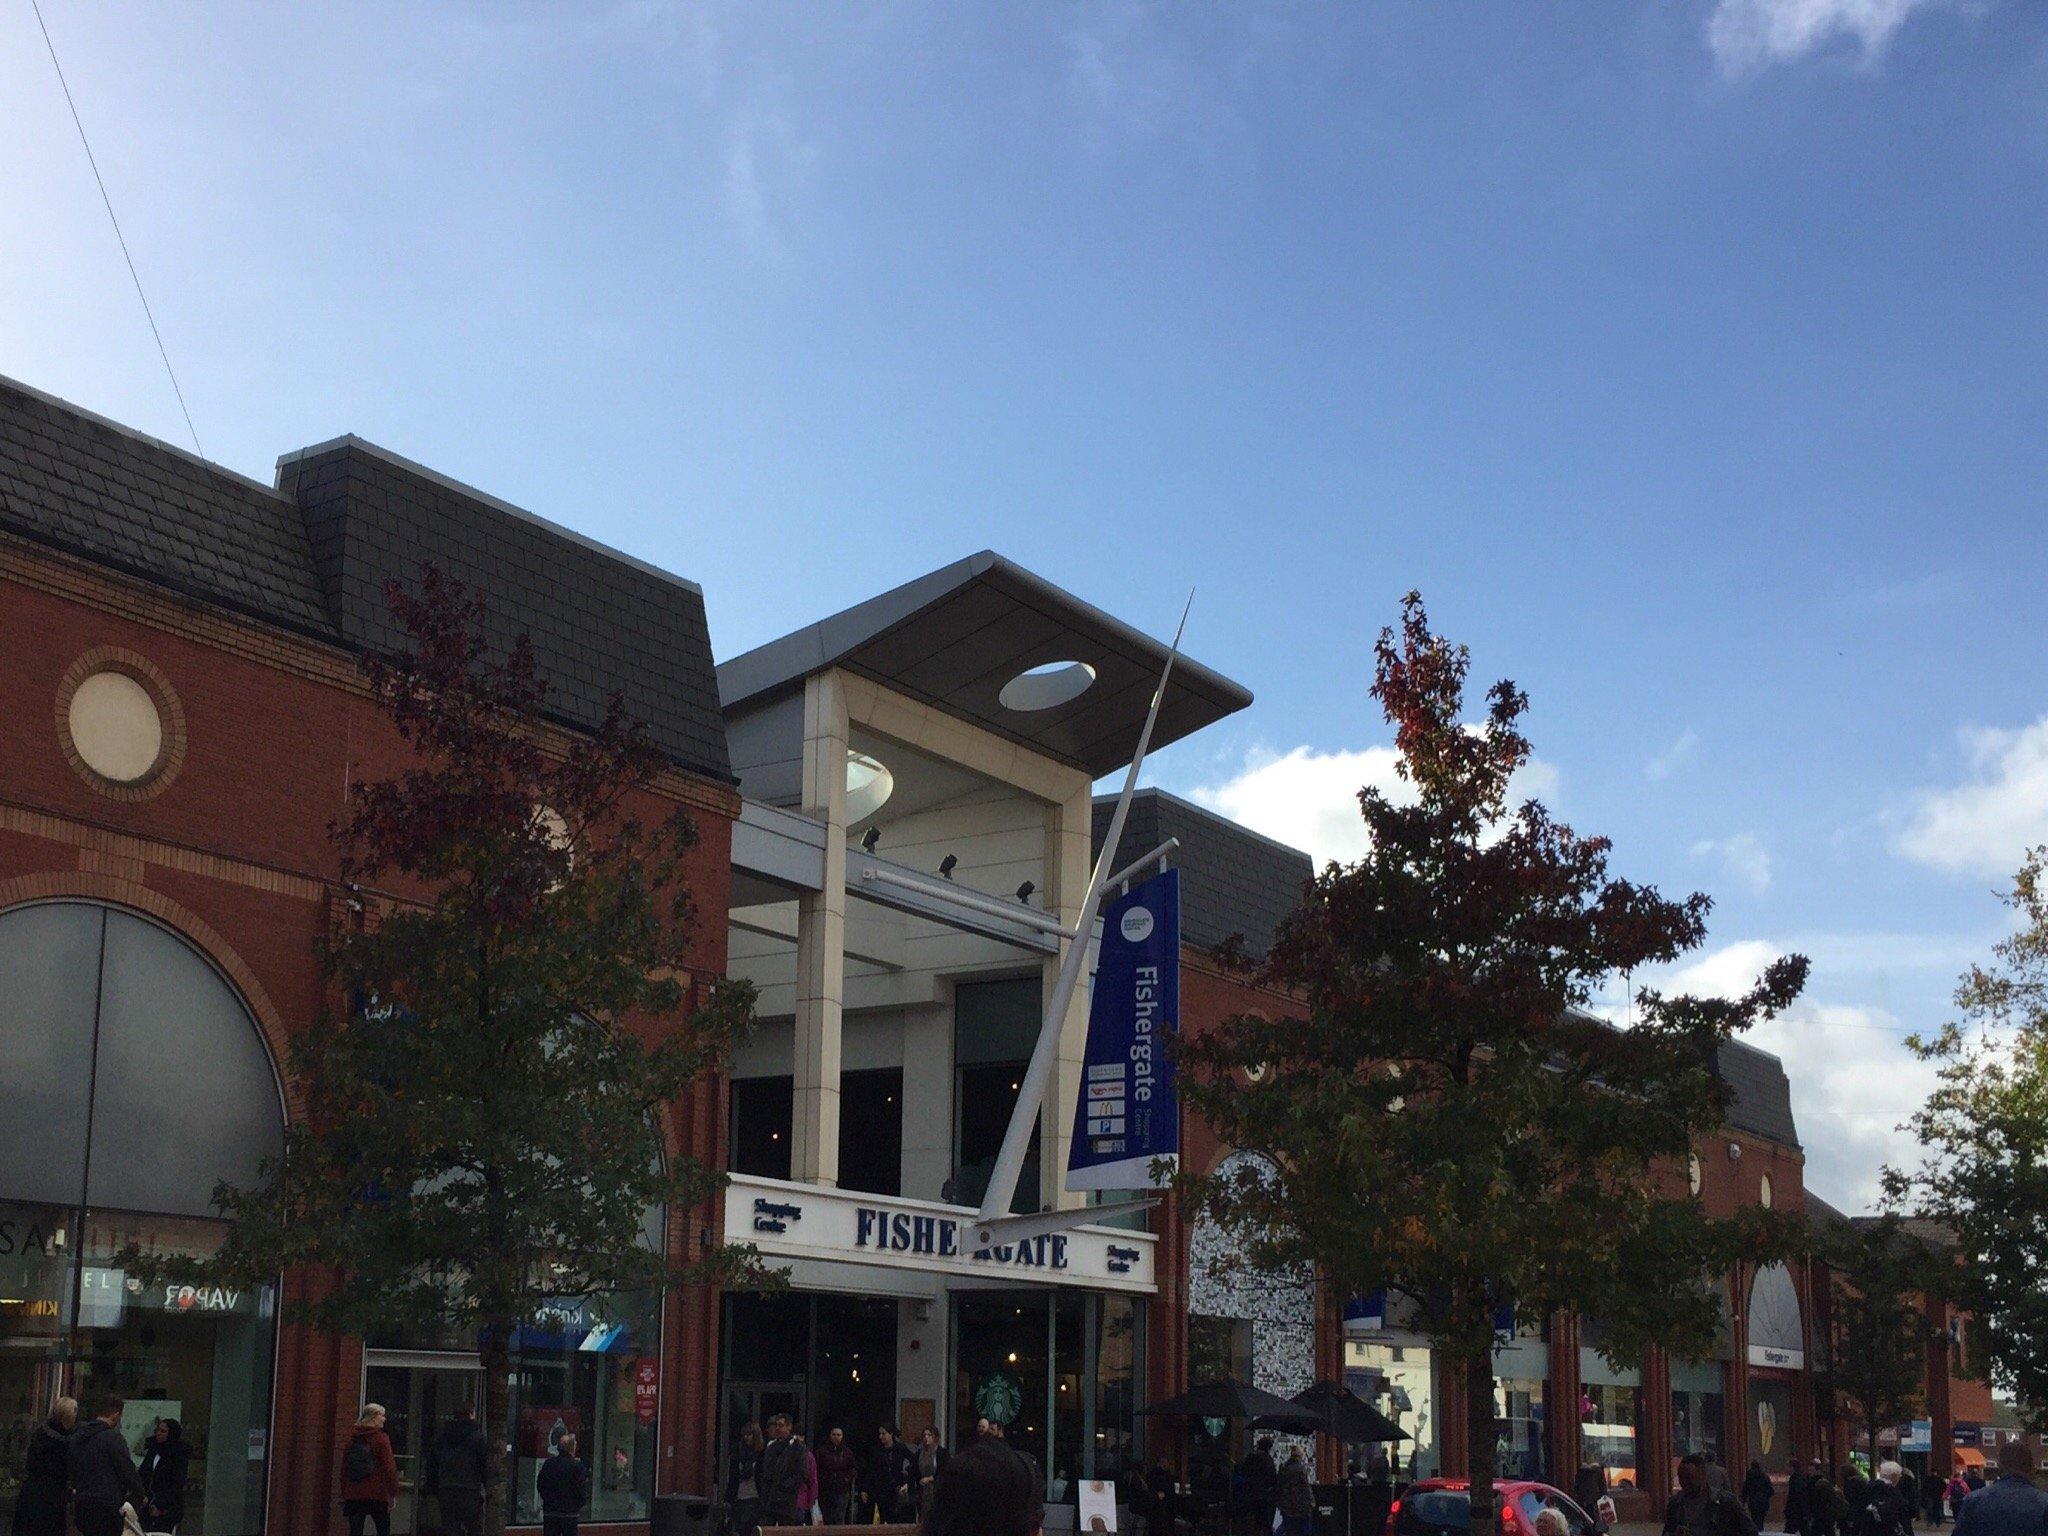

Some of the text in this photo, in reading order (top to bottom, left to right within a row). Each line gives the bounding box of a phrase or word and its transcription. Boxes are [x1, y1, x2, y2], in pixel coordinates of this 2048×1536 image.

[1130, 966, 1158, 1102] Fishergate
[754, 1198, 802, 1220] Shopping
[754, 1217, 787, 1233] Centre
[1107, 1245, 1141, 1263] Shopping
[1108, 1259, 1131, 1273] Centre
